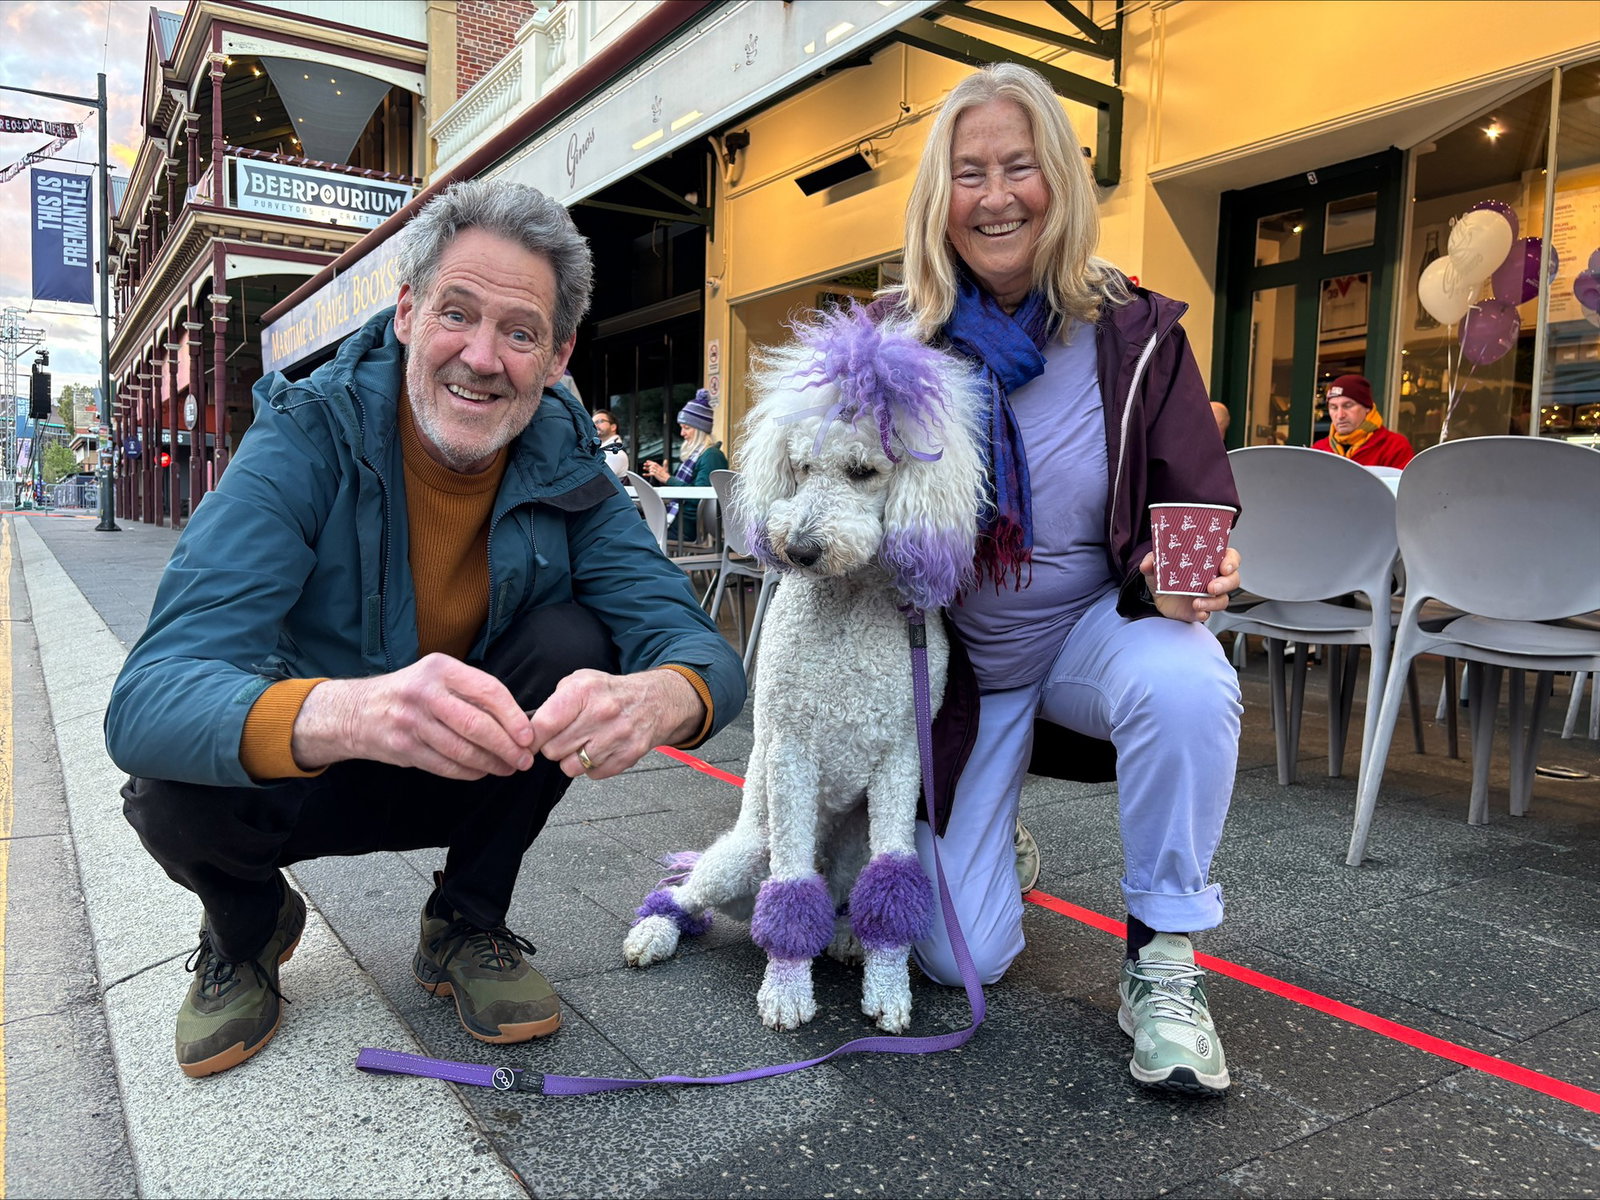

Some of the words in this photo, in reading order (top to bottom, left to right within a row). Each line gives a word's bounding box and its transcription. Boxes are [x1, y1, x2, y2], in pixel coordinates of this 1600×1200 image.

[566, 127, 595, 189] Gino's
[37, 174, 62, 192] IS
[251, 172, 402, 213] BEERPOURIUM
[37, 194, 62, 231] THIS
[63, 178, 88, 268] FREMANTLE
[253, 199, 314, 215] PURVEYORS
[340, 211, 369, 223] CRAFT
[271, 318, 307, 363] MARITIME
[315, 291, 349, 337] TRAVEL
[352, 255, 400, 316] BOOKS
